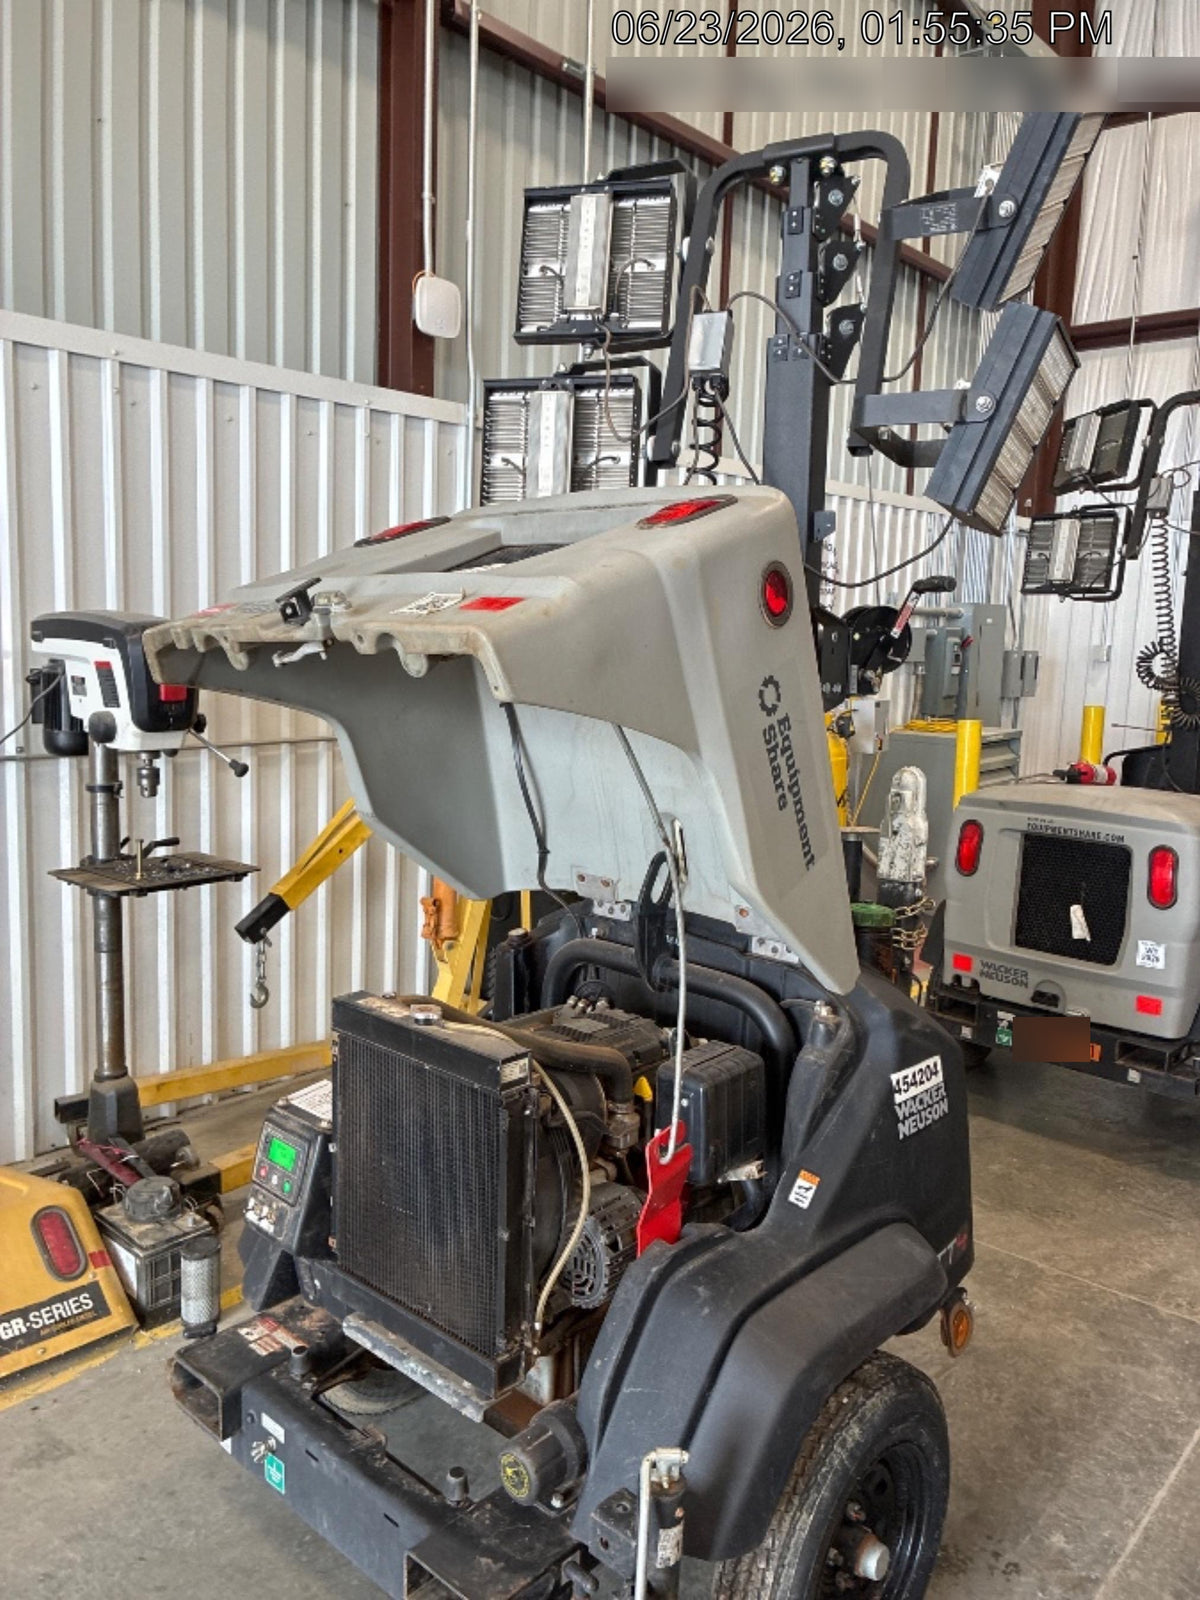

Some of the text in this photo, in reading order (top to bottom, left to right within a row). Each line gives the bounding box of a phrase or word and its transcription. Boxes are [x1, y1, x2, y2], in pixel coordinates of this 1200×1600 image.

[763, 723, 788, 811] Share
[777, 713, 815, 871] Equipment
[979, 959, 1029, 980] WACKER
[979, 969, 1029, 989] NEUSON
[895, 1061, 940, 1096] 454204
[894, 1082, 947, 1121] WACKER
[897, 1098, 949, 1141] NEUSON
